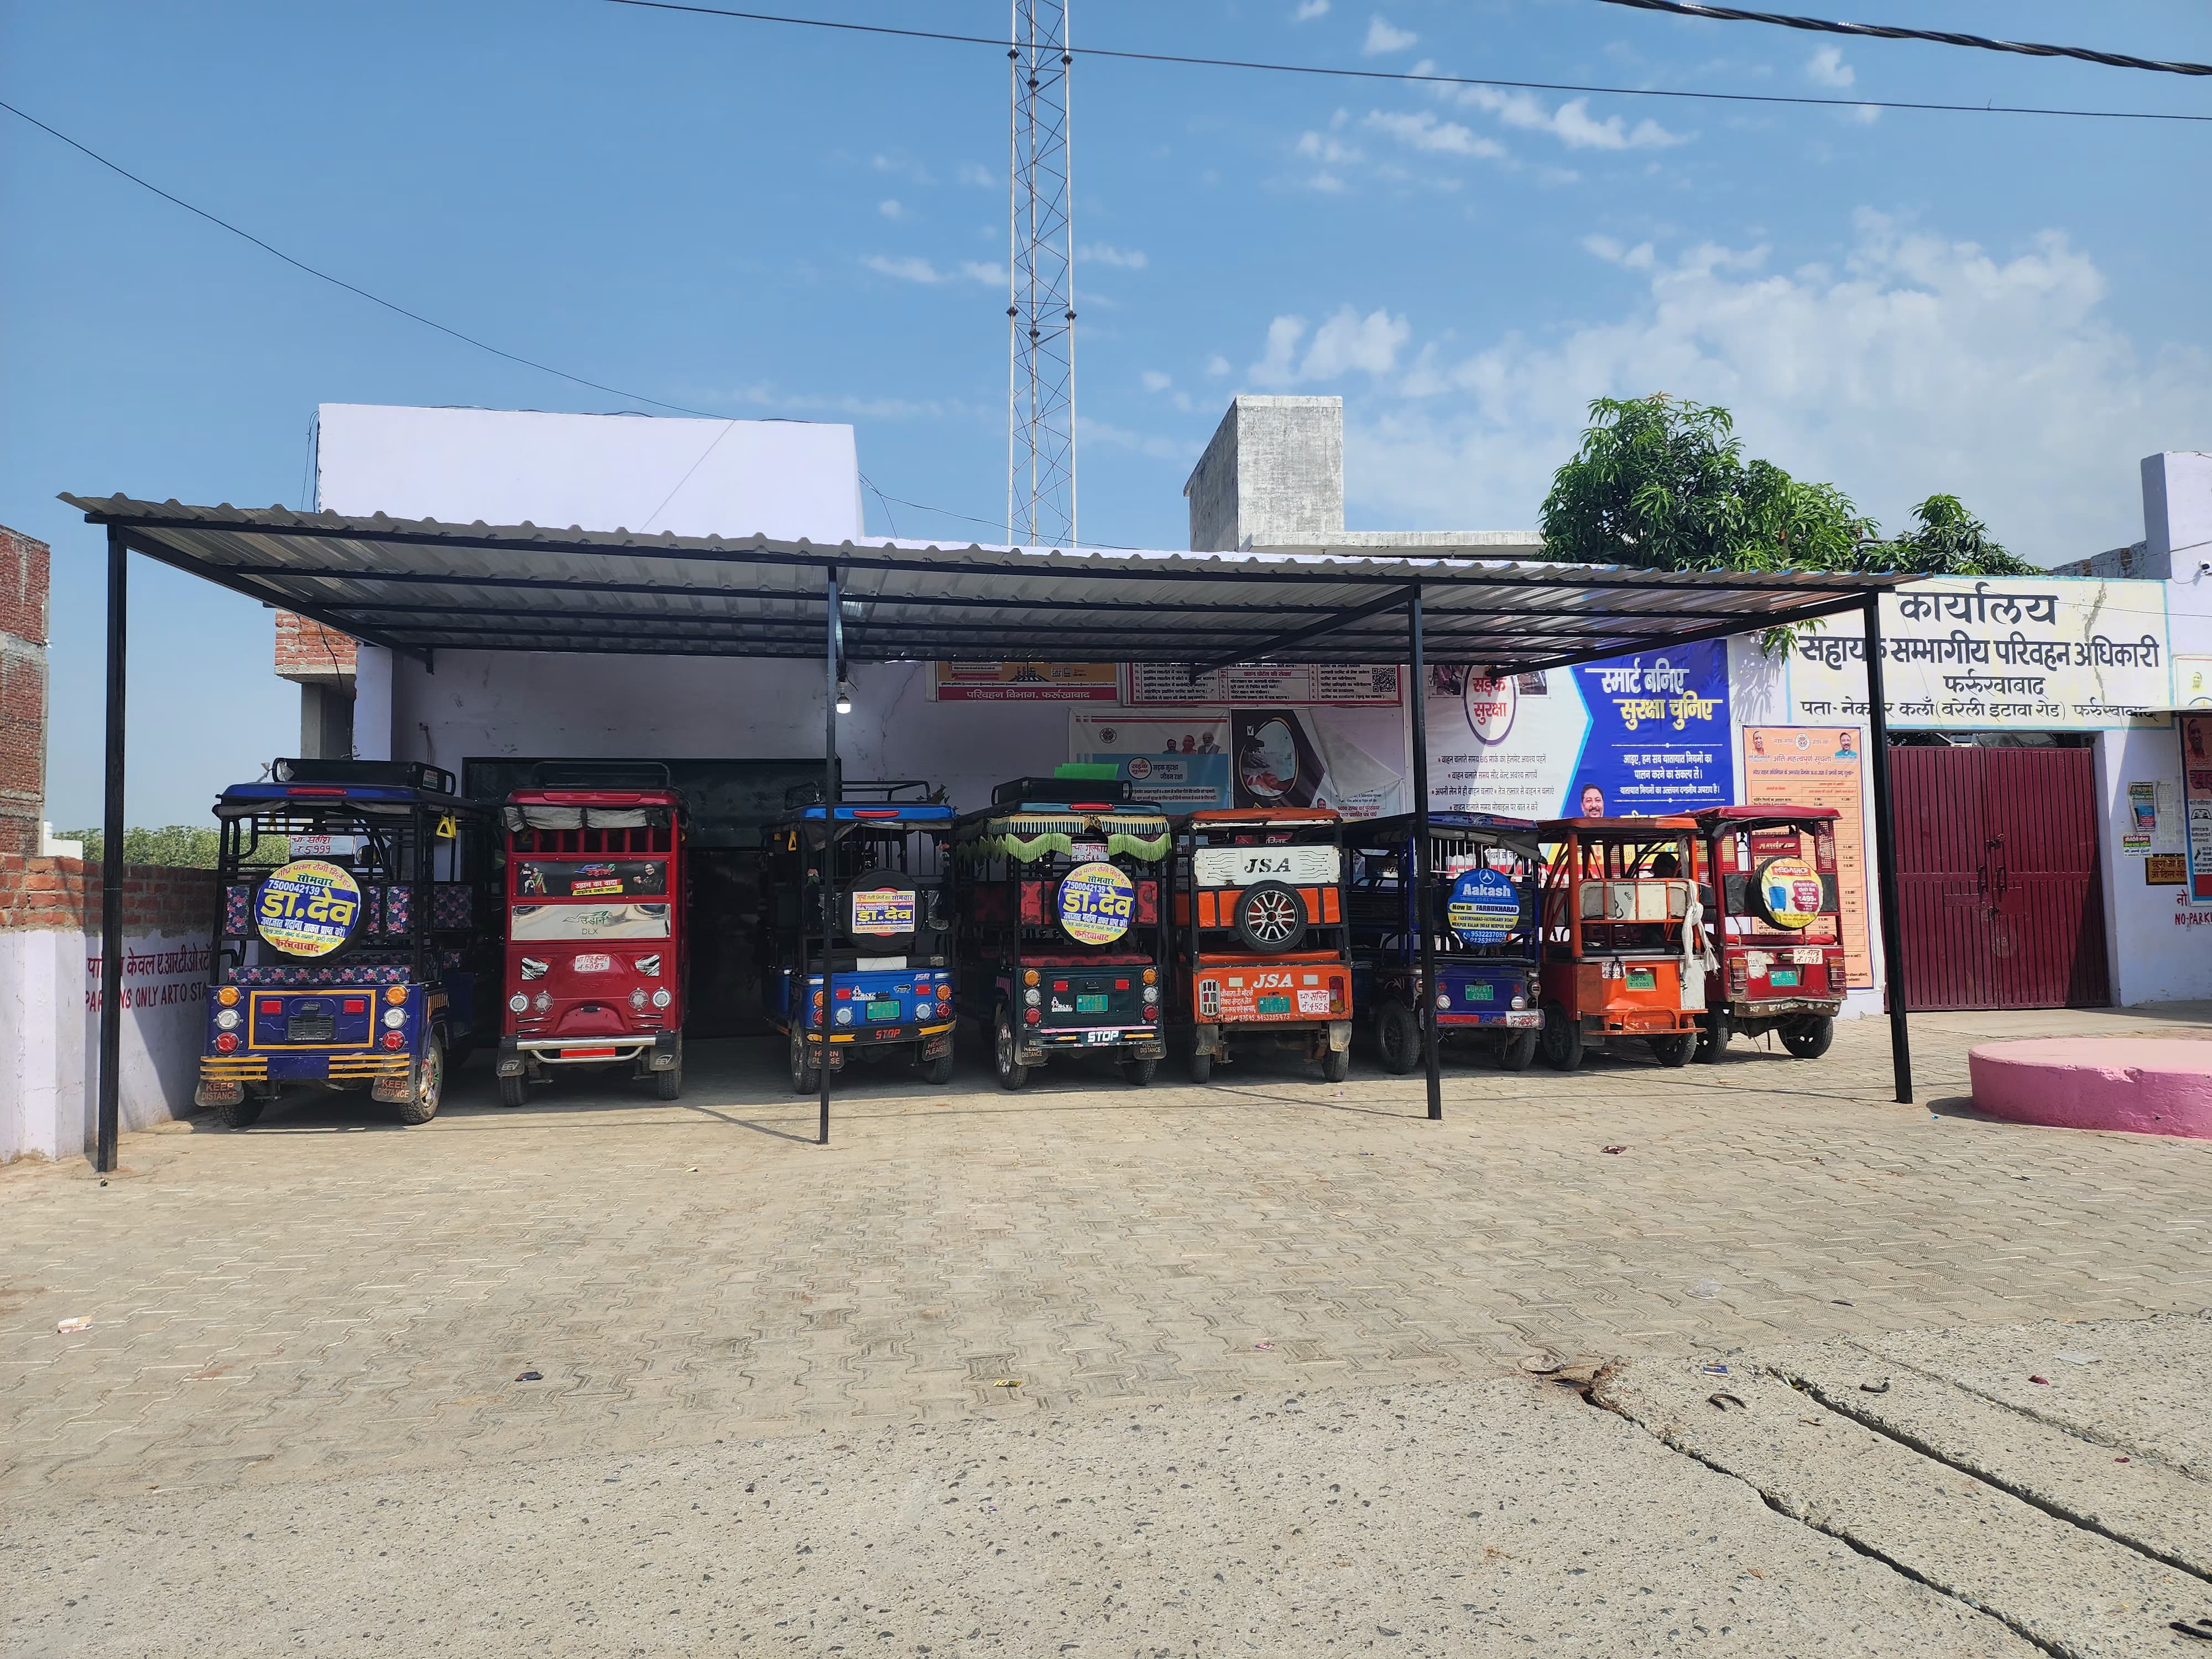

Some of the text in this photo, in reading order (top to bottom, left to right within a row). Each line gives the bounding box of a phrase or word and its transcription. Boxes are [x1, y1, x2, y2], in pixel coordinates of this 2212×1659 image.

[1897, 582, 2059, 625] कार्यालय
[1890, 629, 1990, 664] सम्भागीय
[1994, 631, 2071, 671] परिवहन
[2074, 634, 2159, 667] अधिकारी
[1585, 658, 1689, 694] स्मार्ट बनिए
[967, 690, 1039, 699] परिवहन विभाग,
[1473, 702, 1507, 726] सुरक्षा
[1613, 691, 1723, 730] सुरक्षा चुनिए
[1800, 701, 1837, 715] पता-
[1989, 703, 2033, 722] इटावा
[1442, 755, 1453, 764] वाहन
[1454, 754, 1467, 763] चलाते
[1641, 754, 1651, 764] हम
[1663, 754, 1685, 764] यातायात
[1686, 751, 1703, 763] नियमों
[1705, 754, 1712, 764] का
[1773, 754, 1785, 762] अति
[1787, 754, 1813, 765] महत्वपूर्ण
[1814, 755, 1832, 765] सूचना
[1452, 771, 1463, 780] वाहन
[1464, 769, 1477, 779] चलाते
[1634, 769, 1650, 779] पालन
[1652, 766, 1665, 779] करने
[1666, 769, 1674, 779] का
[1675, 766, 1692, 779] संकल्प
[1435, 786, 1448, 796] अपनी
[1463, 786, 1467, 796] ही
[1468, 787, 1479, 796] वाहन
[1525, 787, 1537, 796] वाहन
[1620, 786, 1639, 795] यातायात
[1656, 786, 1662, 795] का
[1466, 802, 1479, 811] चलाते
[307, 834, 332, 844] सतीश
[313, 863, 328, 872] रोगी
[1245, 858, 1291, 873] JSA
[296, 873, 333, 888] सोमवार
[1088, 875, 1115, 885] सोमवार
[269, 879, 320, 896] 7500042139
[1067, 881, 1105, 893] 7500042139
[1463, 884, 1511, 897] Aakash
[2177, 889, 2188, 906] नो
[304, 923, 320, 933] ताकत
[127, 947, 156, 976] केवल
[1253, 974, 1293, 988] JSA
[86, 988, 132, 1012] PARNG
[136, 985, 159, 1008] ONLY
[876, 1029, 901, 1040] STOP
[1088, 1031, 1119, 1043] STOP
[926, 1045, 947, 1056] PLEASE
[501, 1061, 519, 1071] EEV
[655, 1055, 672, 1066] EEV
[206, 1083, 234, 1092] KEEP
[382, 1078, 408, 1089] KEEP
[201, 1091, 238, 1100] DISTANCE
[377, 1087, 410, 1099] DISTANCE
